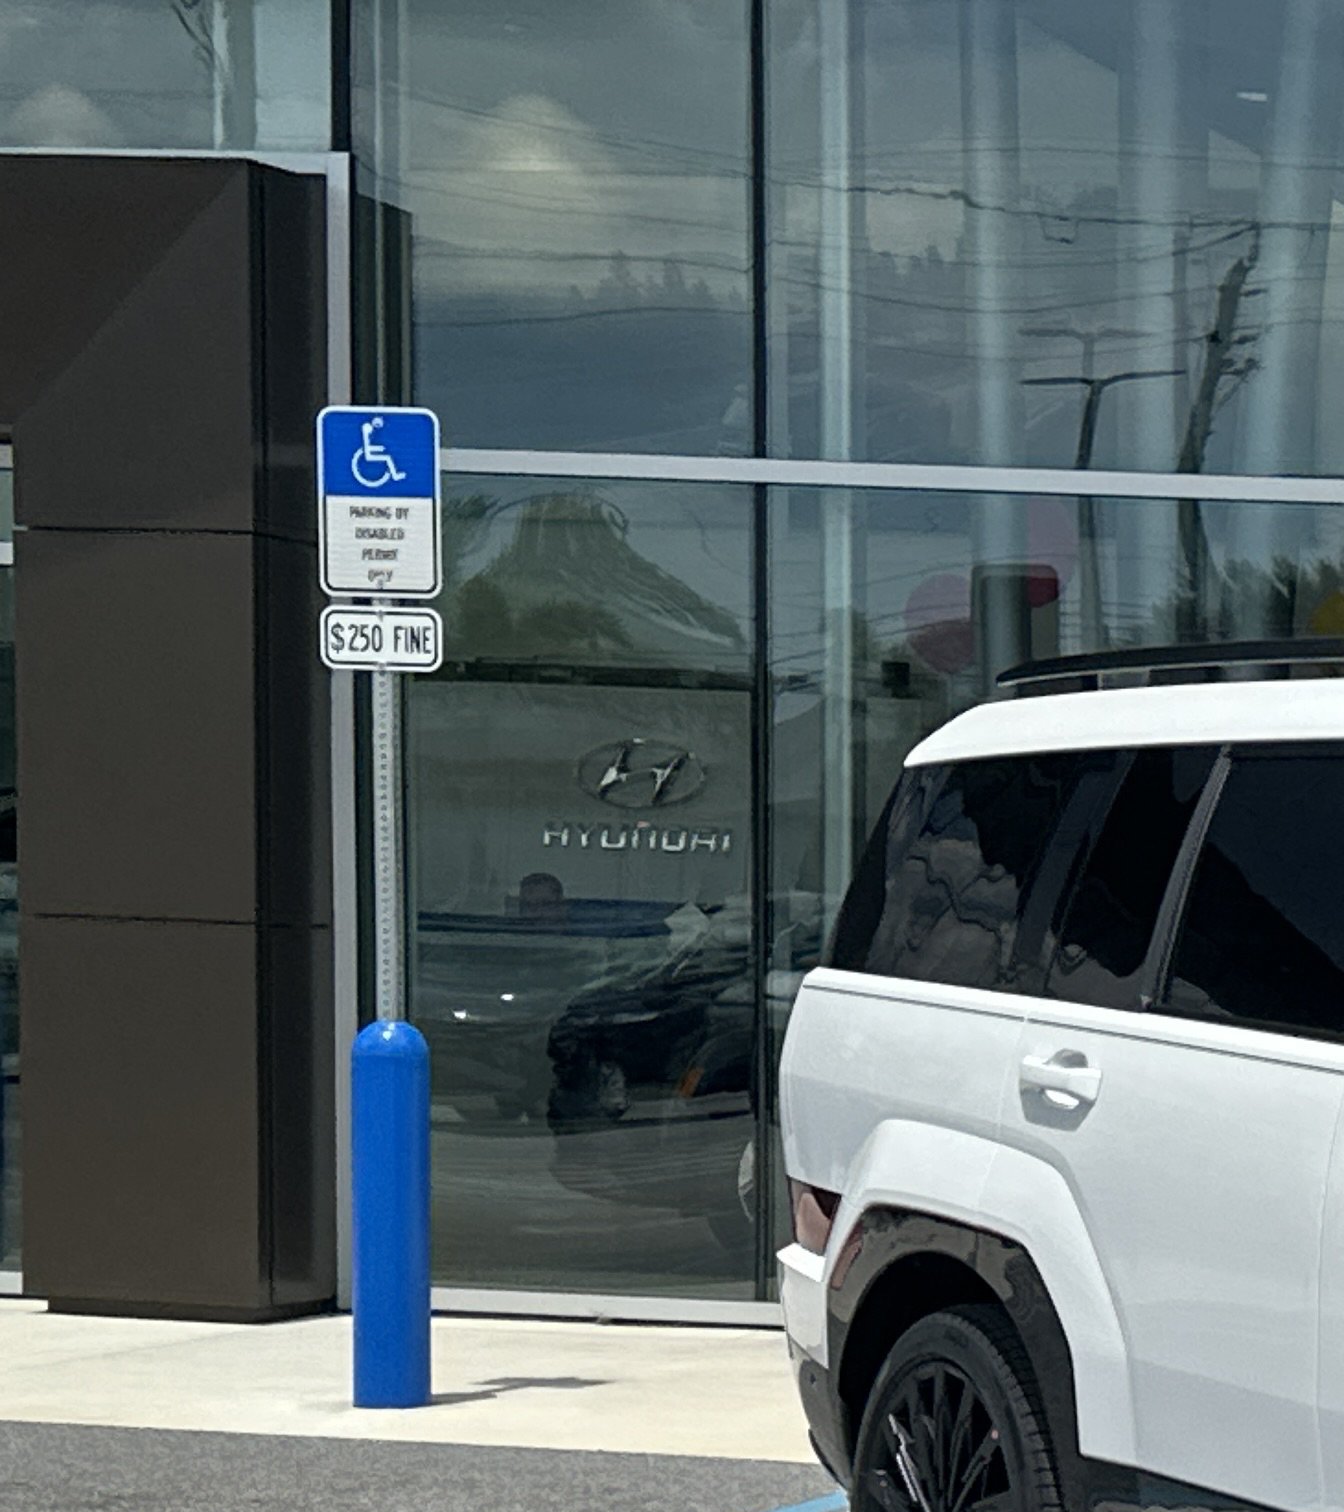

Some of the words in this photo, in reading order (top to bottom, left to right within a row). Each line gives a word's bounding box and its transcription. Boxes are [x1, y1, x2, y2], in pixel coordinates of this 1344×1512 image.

[330, 621, 384, 655] $250
[393, 625, 432, 655] FINE
[543, 822, 733, 853] HYUNDAI
